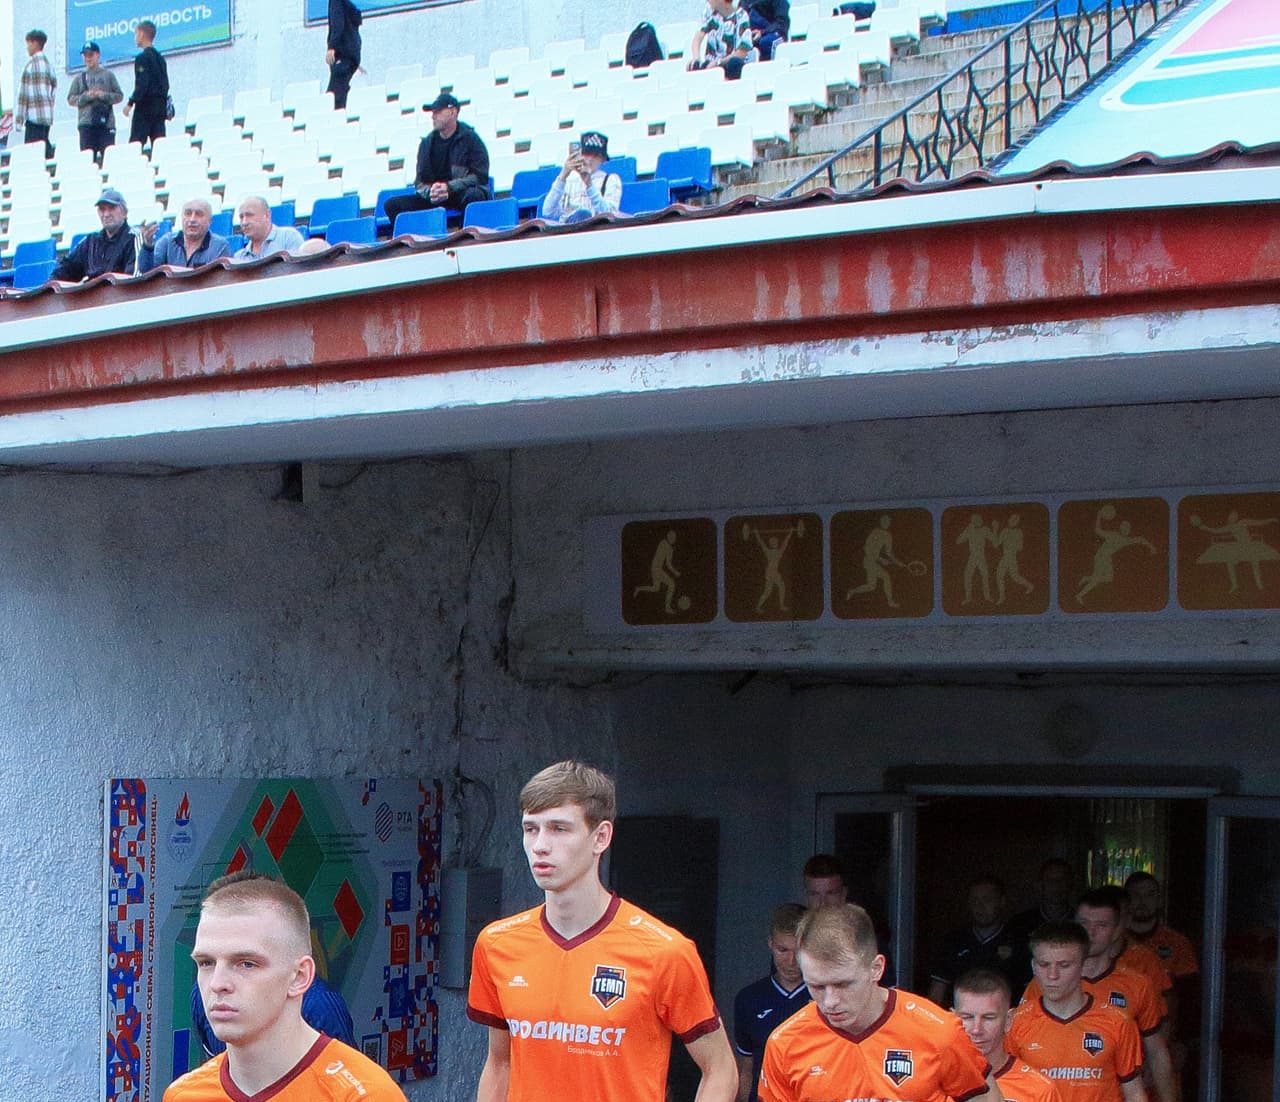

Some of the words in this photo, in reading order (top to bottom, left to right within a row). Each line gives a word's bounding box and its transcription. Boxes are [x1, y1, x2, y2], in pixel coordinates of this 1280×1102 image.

[148, 891, 156, 963] СТАДИОНА
[595, 978, 623, 996] ТЕМП
[887, 1060, 911, 1074] ТЕМП
